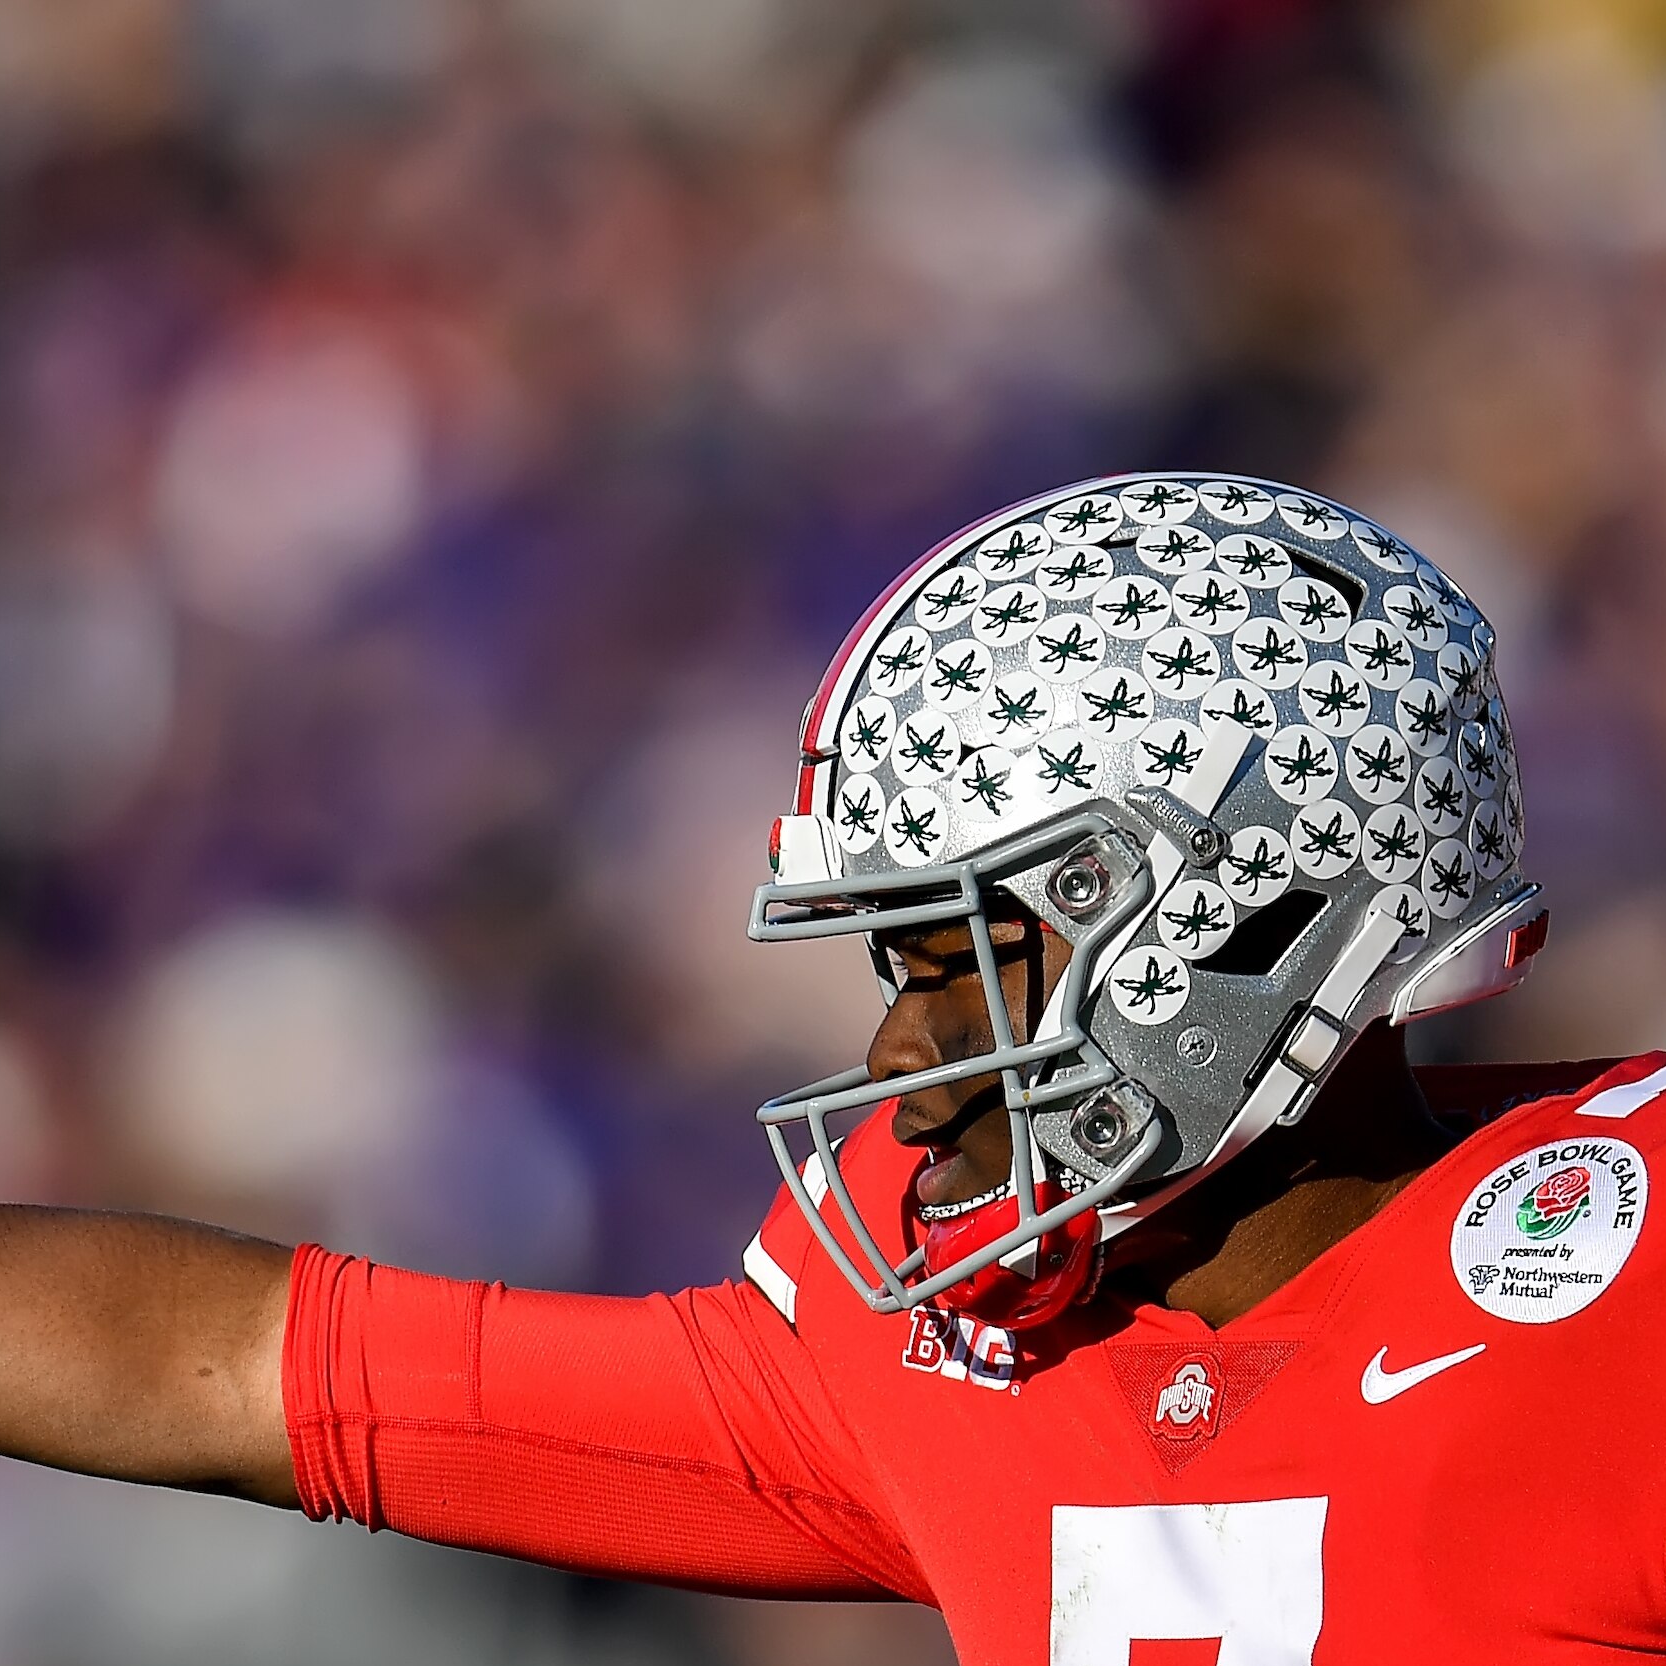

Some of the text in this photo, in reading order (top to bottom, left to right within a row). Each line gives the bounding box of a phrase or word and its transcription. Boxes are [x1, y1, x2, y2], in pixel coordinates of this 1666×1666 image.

[1465, 1143, 1639, 1230] ROSE BOWL GAME
[1559, 1245, 1574, 1261] by
[1503, 1265, 1603, 1285] Northwestern
[1499, 1282, 1555, 1299] Mutual
